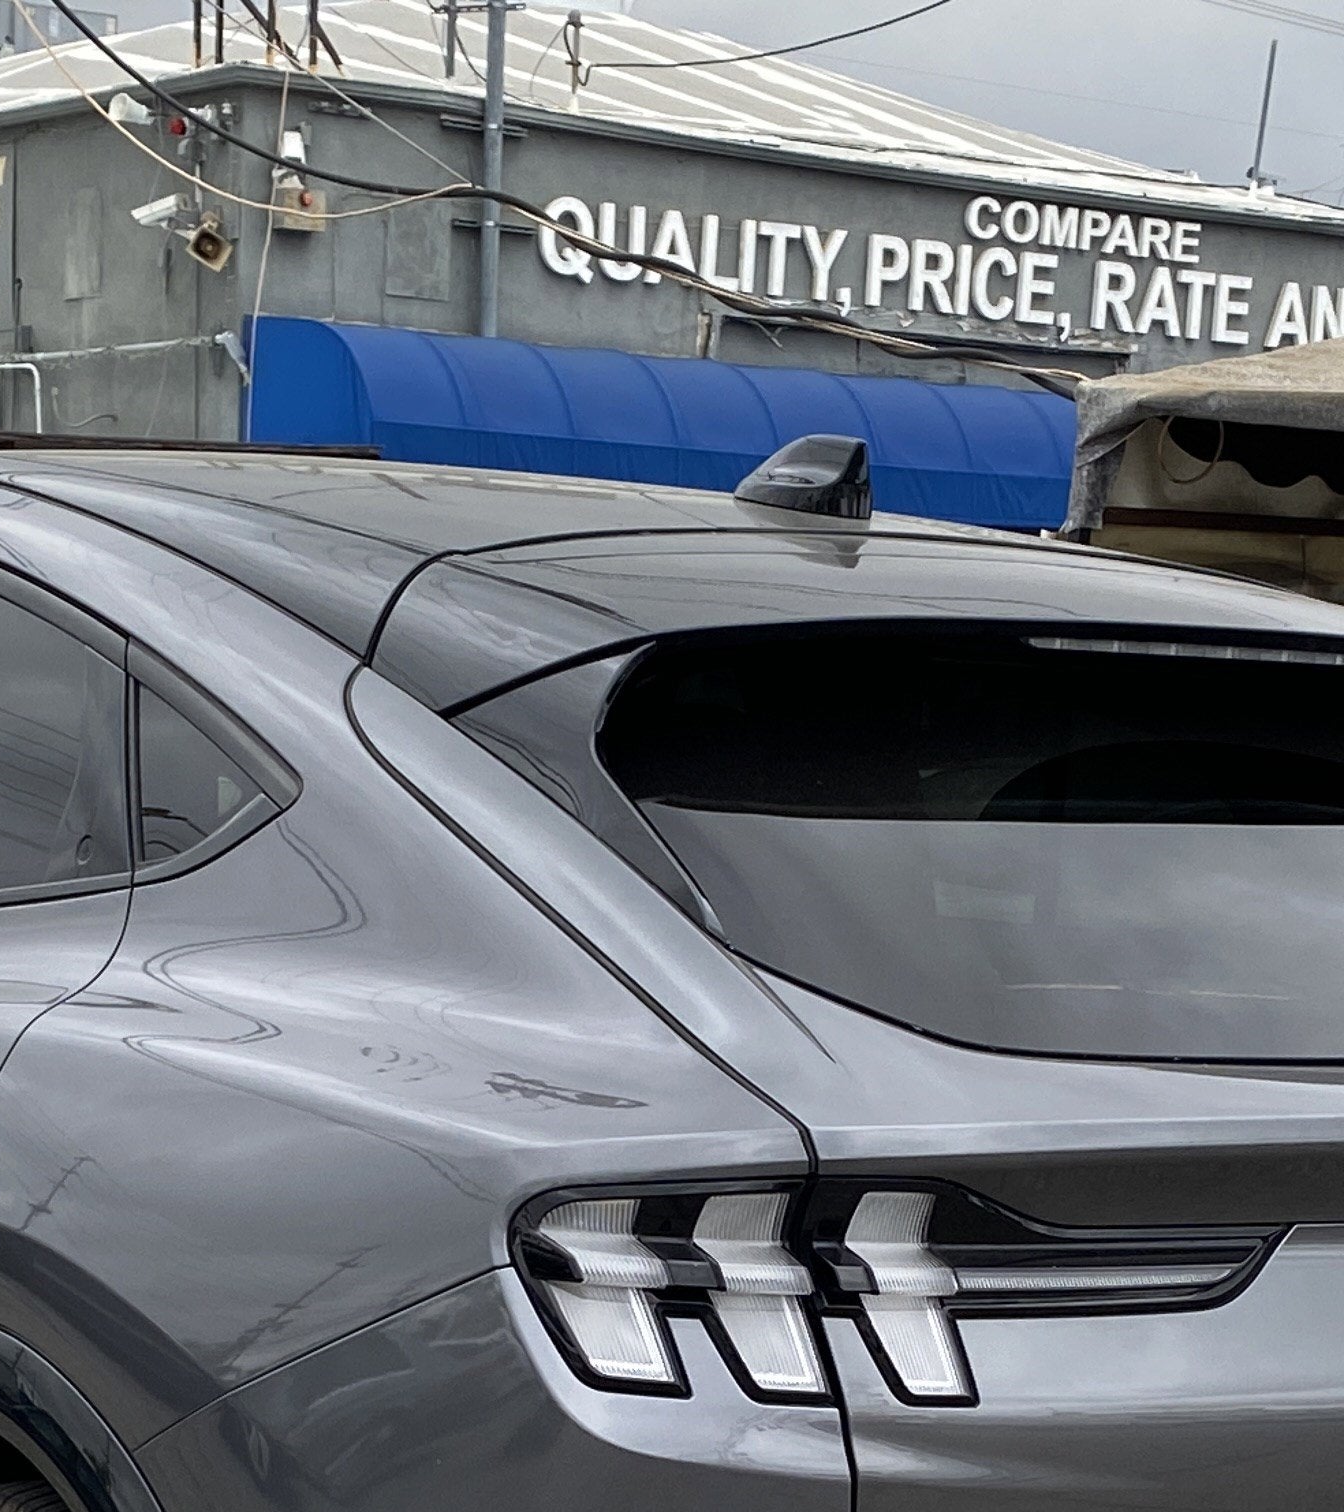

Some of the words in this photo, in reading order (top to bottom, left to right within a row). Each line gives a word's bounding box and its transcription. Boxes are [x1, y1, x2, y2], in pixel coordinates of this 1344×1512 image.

[538, 196, 852, 317] QUALITY,
[865, 233, 1071, 342] PRICE,
[1092, 260, 1254, 345] RATE
[964, 196, 1202, 264] COMPARE
